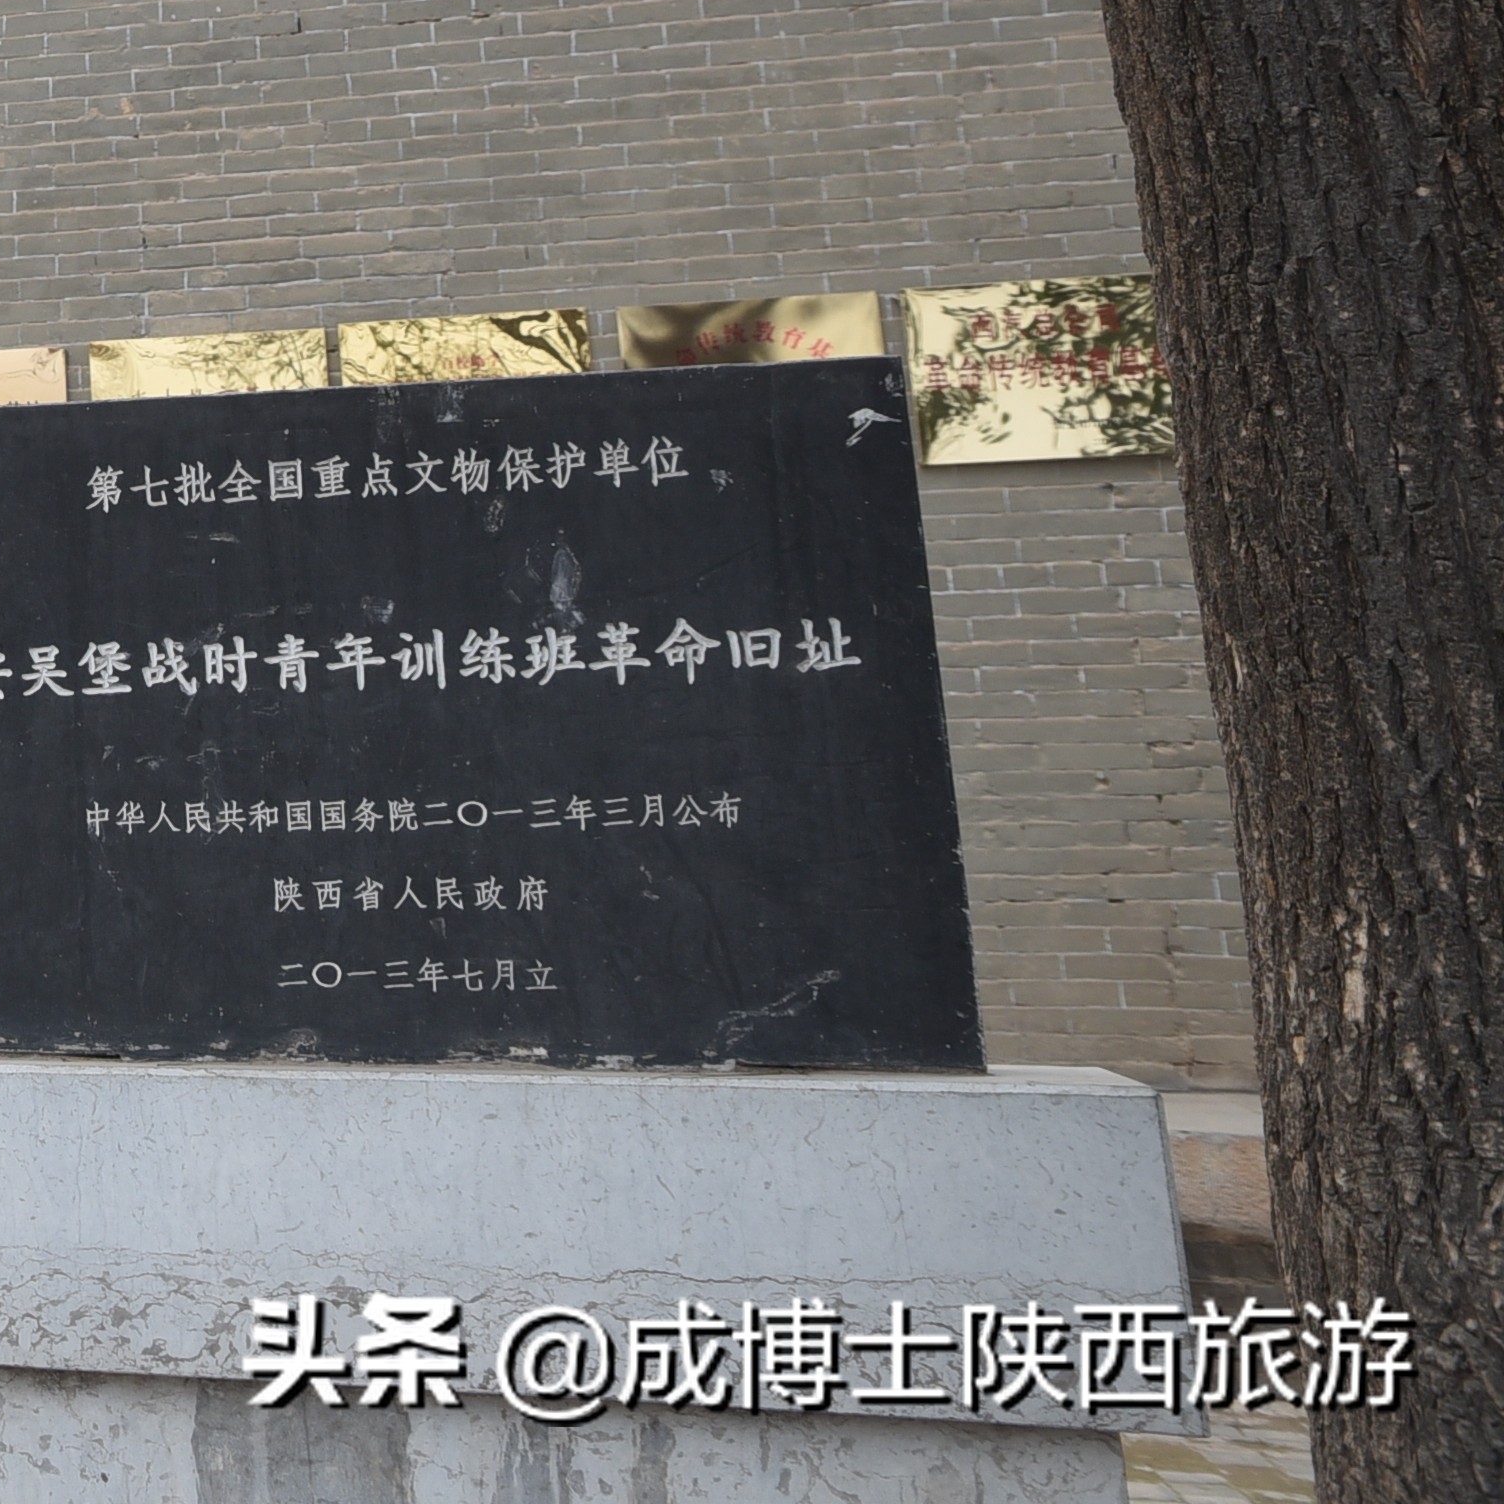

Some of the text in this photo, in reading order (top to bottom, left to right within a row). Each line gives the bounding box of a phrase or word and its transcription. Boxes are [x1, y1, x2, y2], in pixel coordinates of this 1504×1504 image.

[86, 435, 690, 514] 第七批全国重点文物保护单位
[274, 875, 549, 912] 陕西省人民政府
